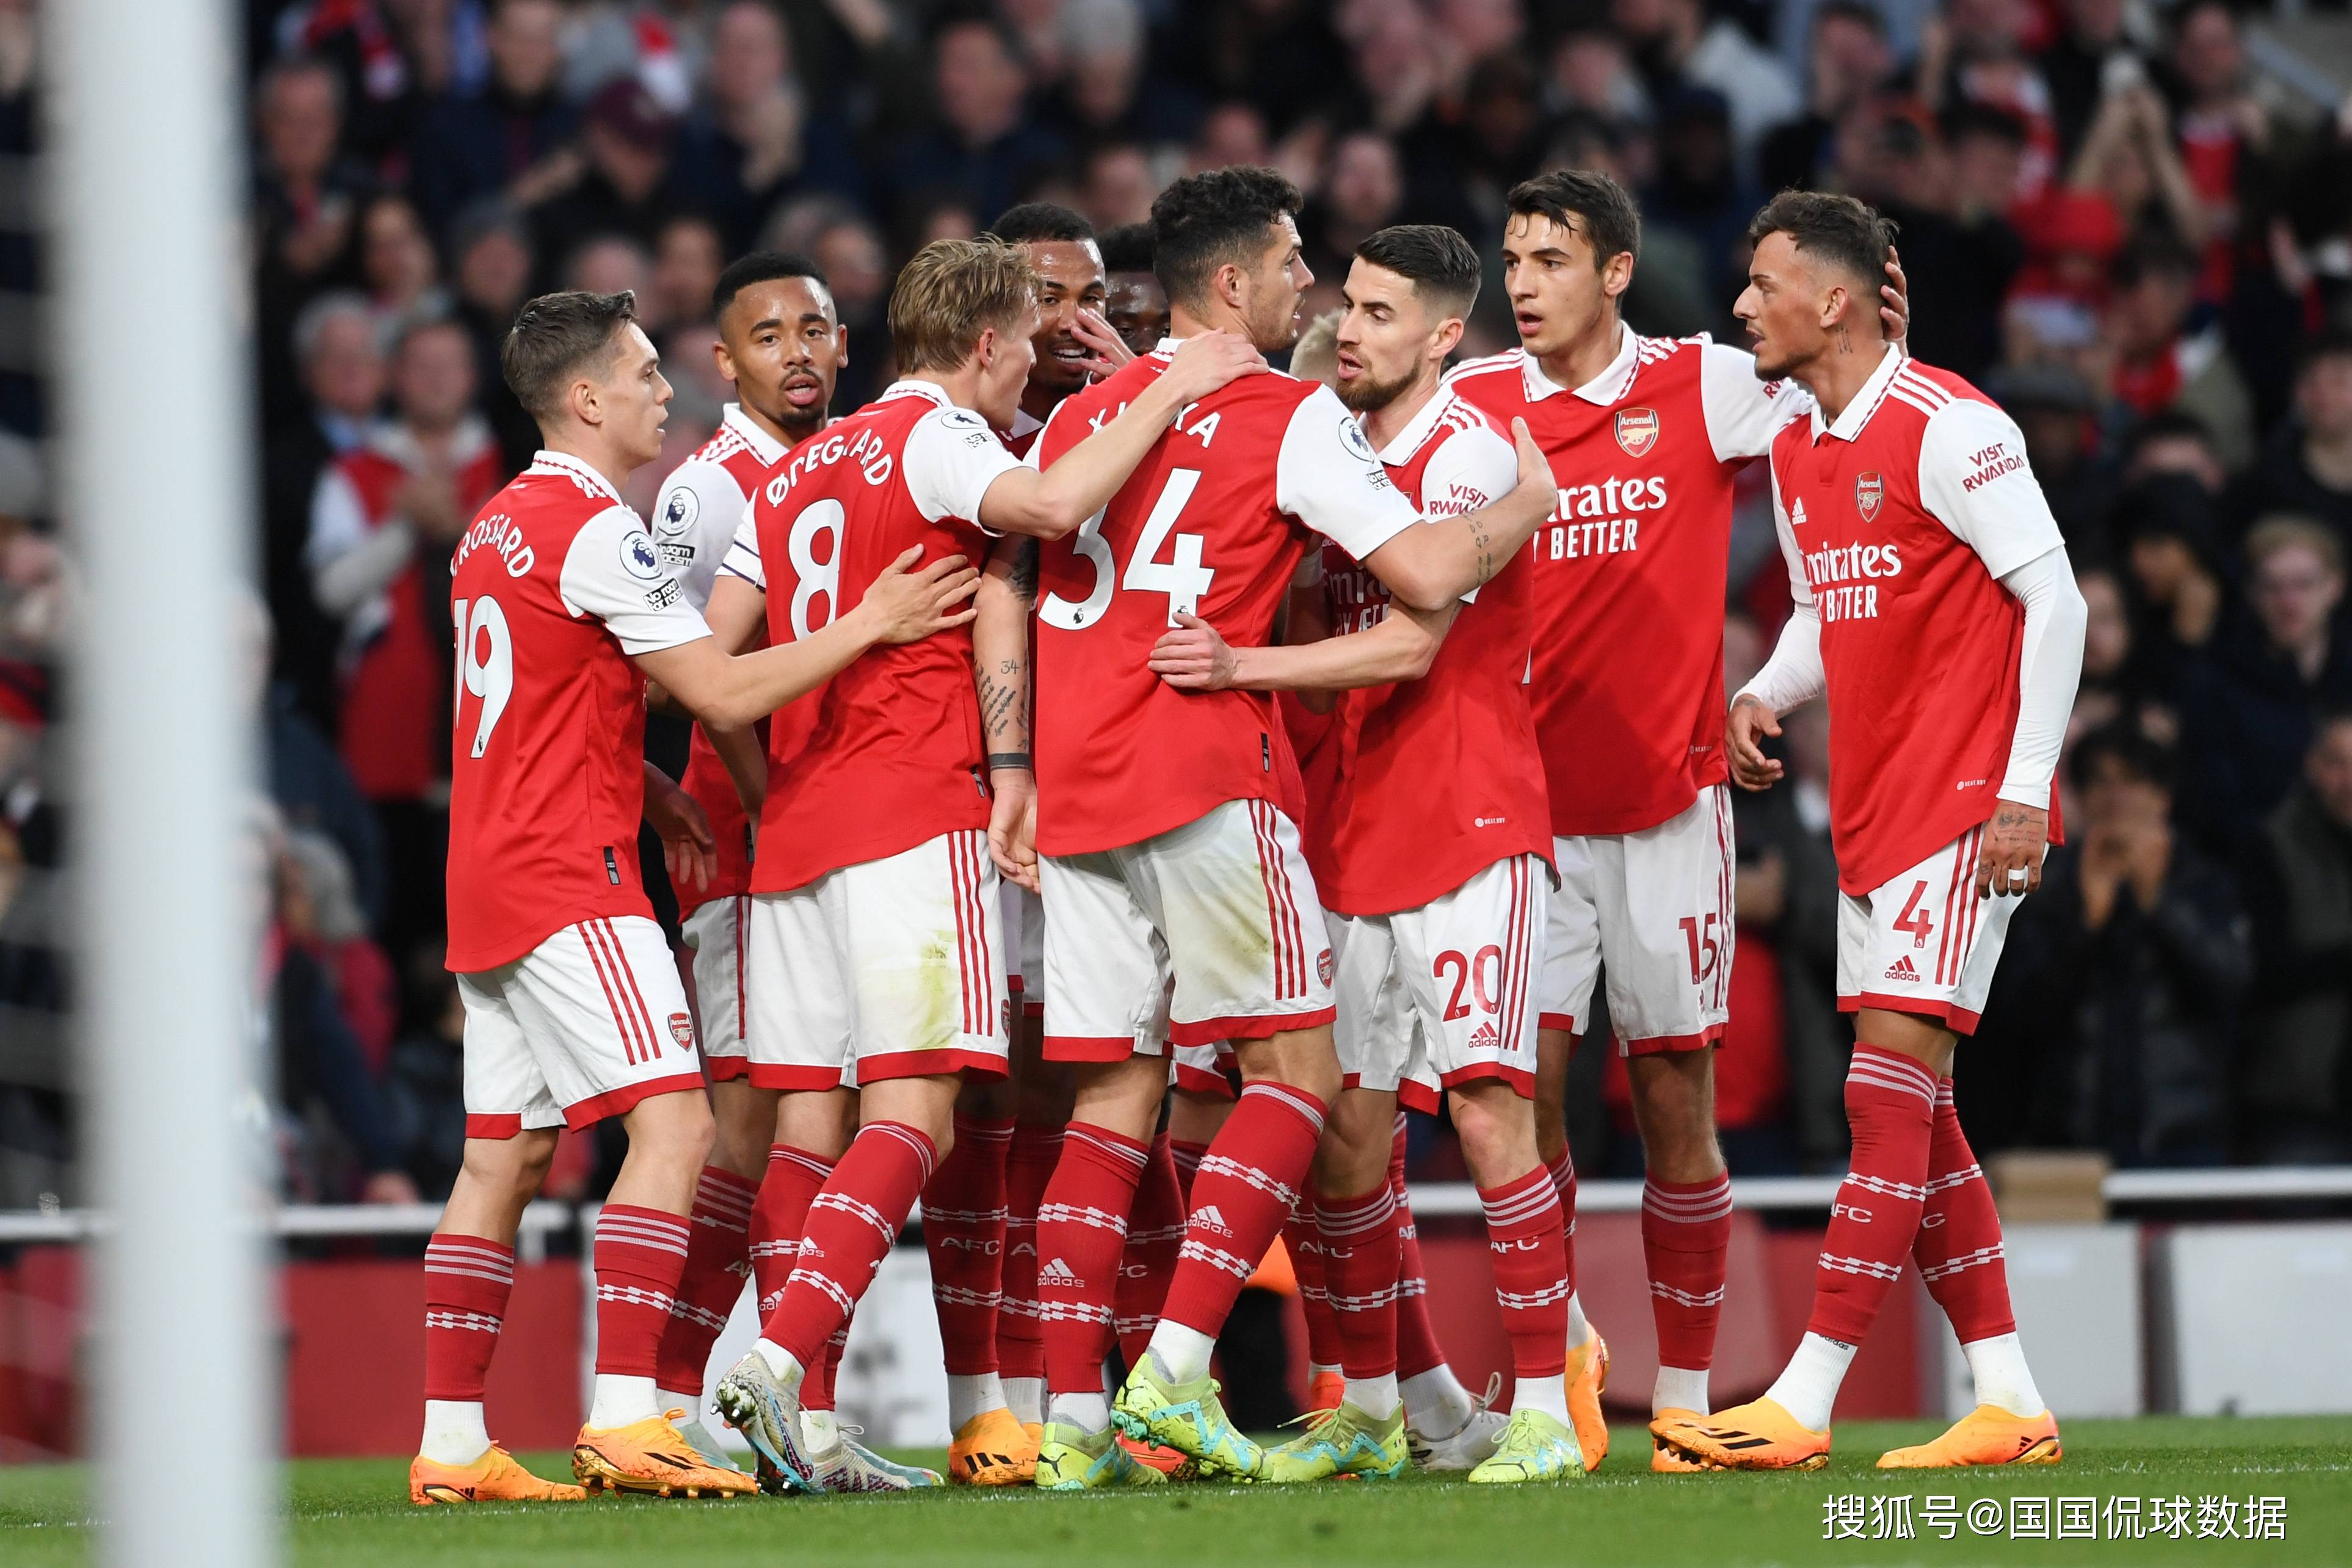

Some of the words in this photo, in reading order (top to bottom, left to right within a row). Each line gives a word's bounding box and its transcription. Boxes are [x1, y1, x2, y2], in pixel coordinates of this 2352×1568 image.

[1088, 401, 1221, 448] XKA
[1620, 416, 1652, 426] Arsenal
[1962, 455, 2025, 493] RWANDA
[1969, 443, 2005, 466] VISIT
[1450, 484, 1489, 508] VISIT
[1547, 475, 1667, 523] rates
[1038, 468, 1215, 630] 34
[1550, 519, 1638, 560] BETTER
[789, 498, 845, 641] 8
[1801, 540, 1902, 586] mirates
[454, 594, 514, 758] 19
[1001, 659, 1020, 675] 34
[1892, 880, 1934, 948] 4
[1679, 912, 1716, 985] 15
[1433, 944, 1503, 1022] 20
[1884, 970, 1921, 982] adidas
[1468, 1038, 1500, 1048] adida
[940, 1237, 1000, 1255] AFC
[1490, 1236, 1540, 1254] AFC
[1037, 1274, 1085, 1288] adidas
